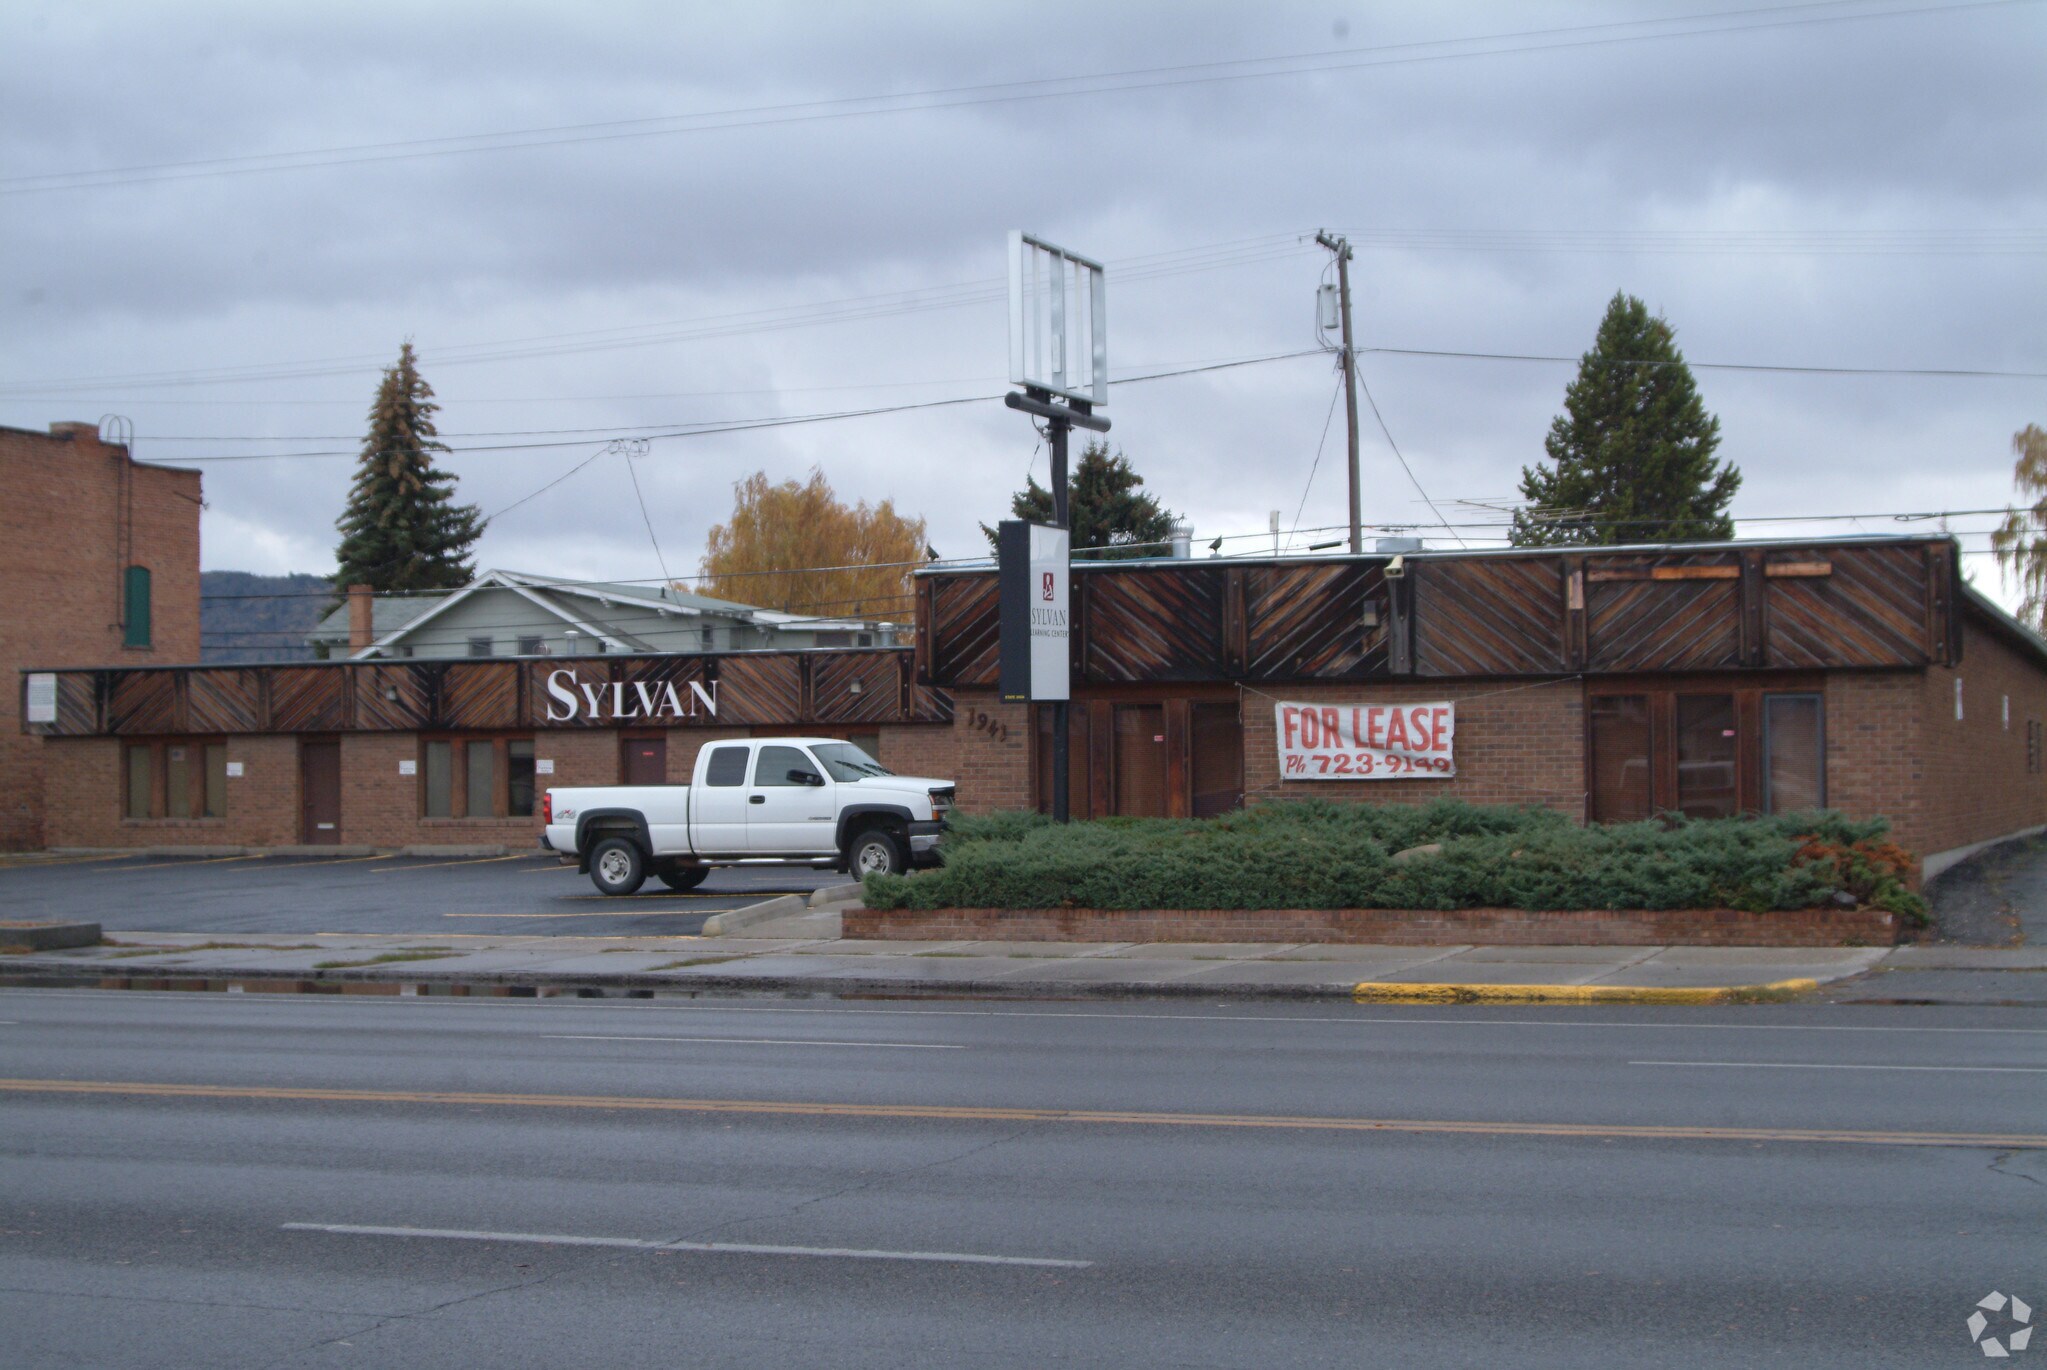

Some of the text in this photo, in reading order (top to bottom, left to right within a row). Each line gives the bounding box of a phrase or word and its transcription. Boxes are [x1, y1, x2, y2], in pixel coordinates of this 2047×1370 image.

[1031, 607, 1066, 626] SYLVAN
[1031, 629, 1069, 638] LEARNING CENTER
[547, 669, 718, 721] SYLVAN
[1283, 707, 1449, 752] FOR LEASE
[1286, 753, 1450, 775] Ph 723-9149
